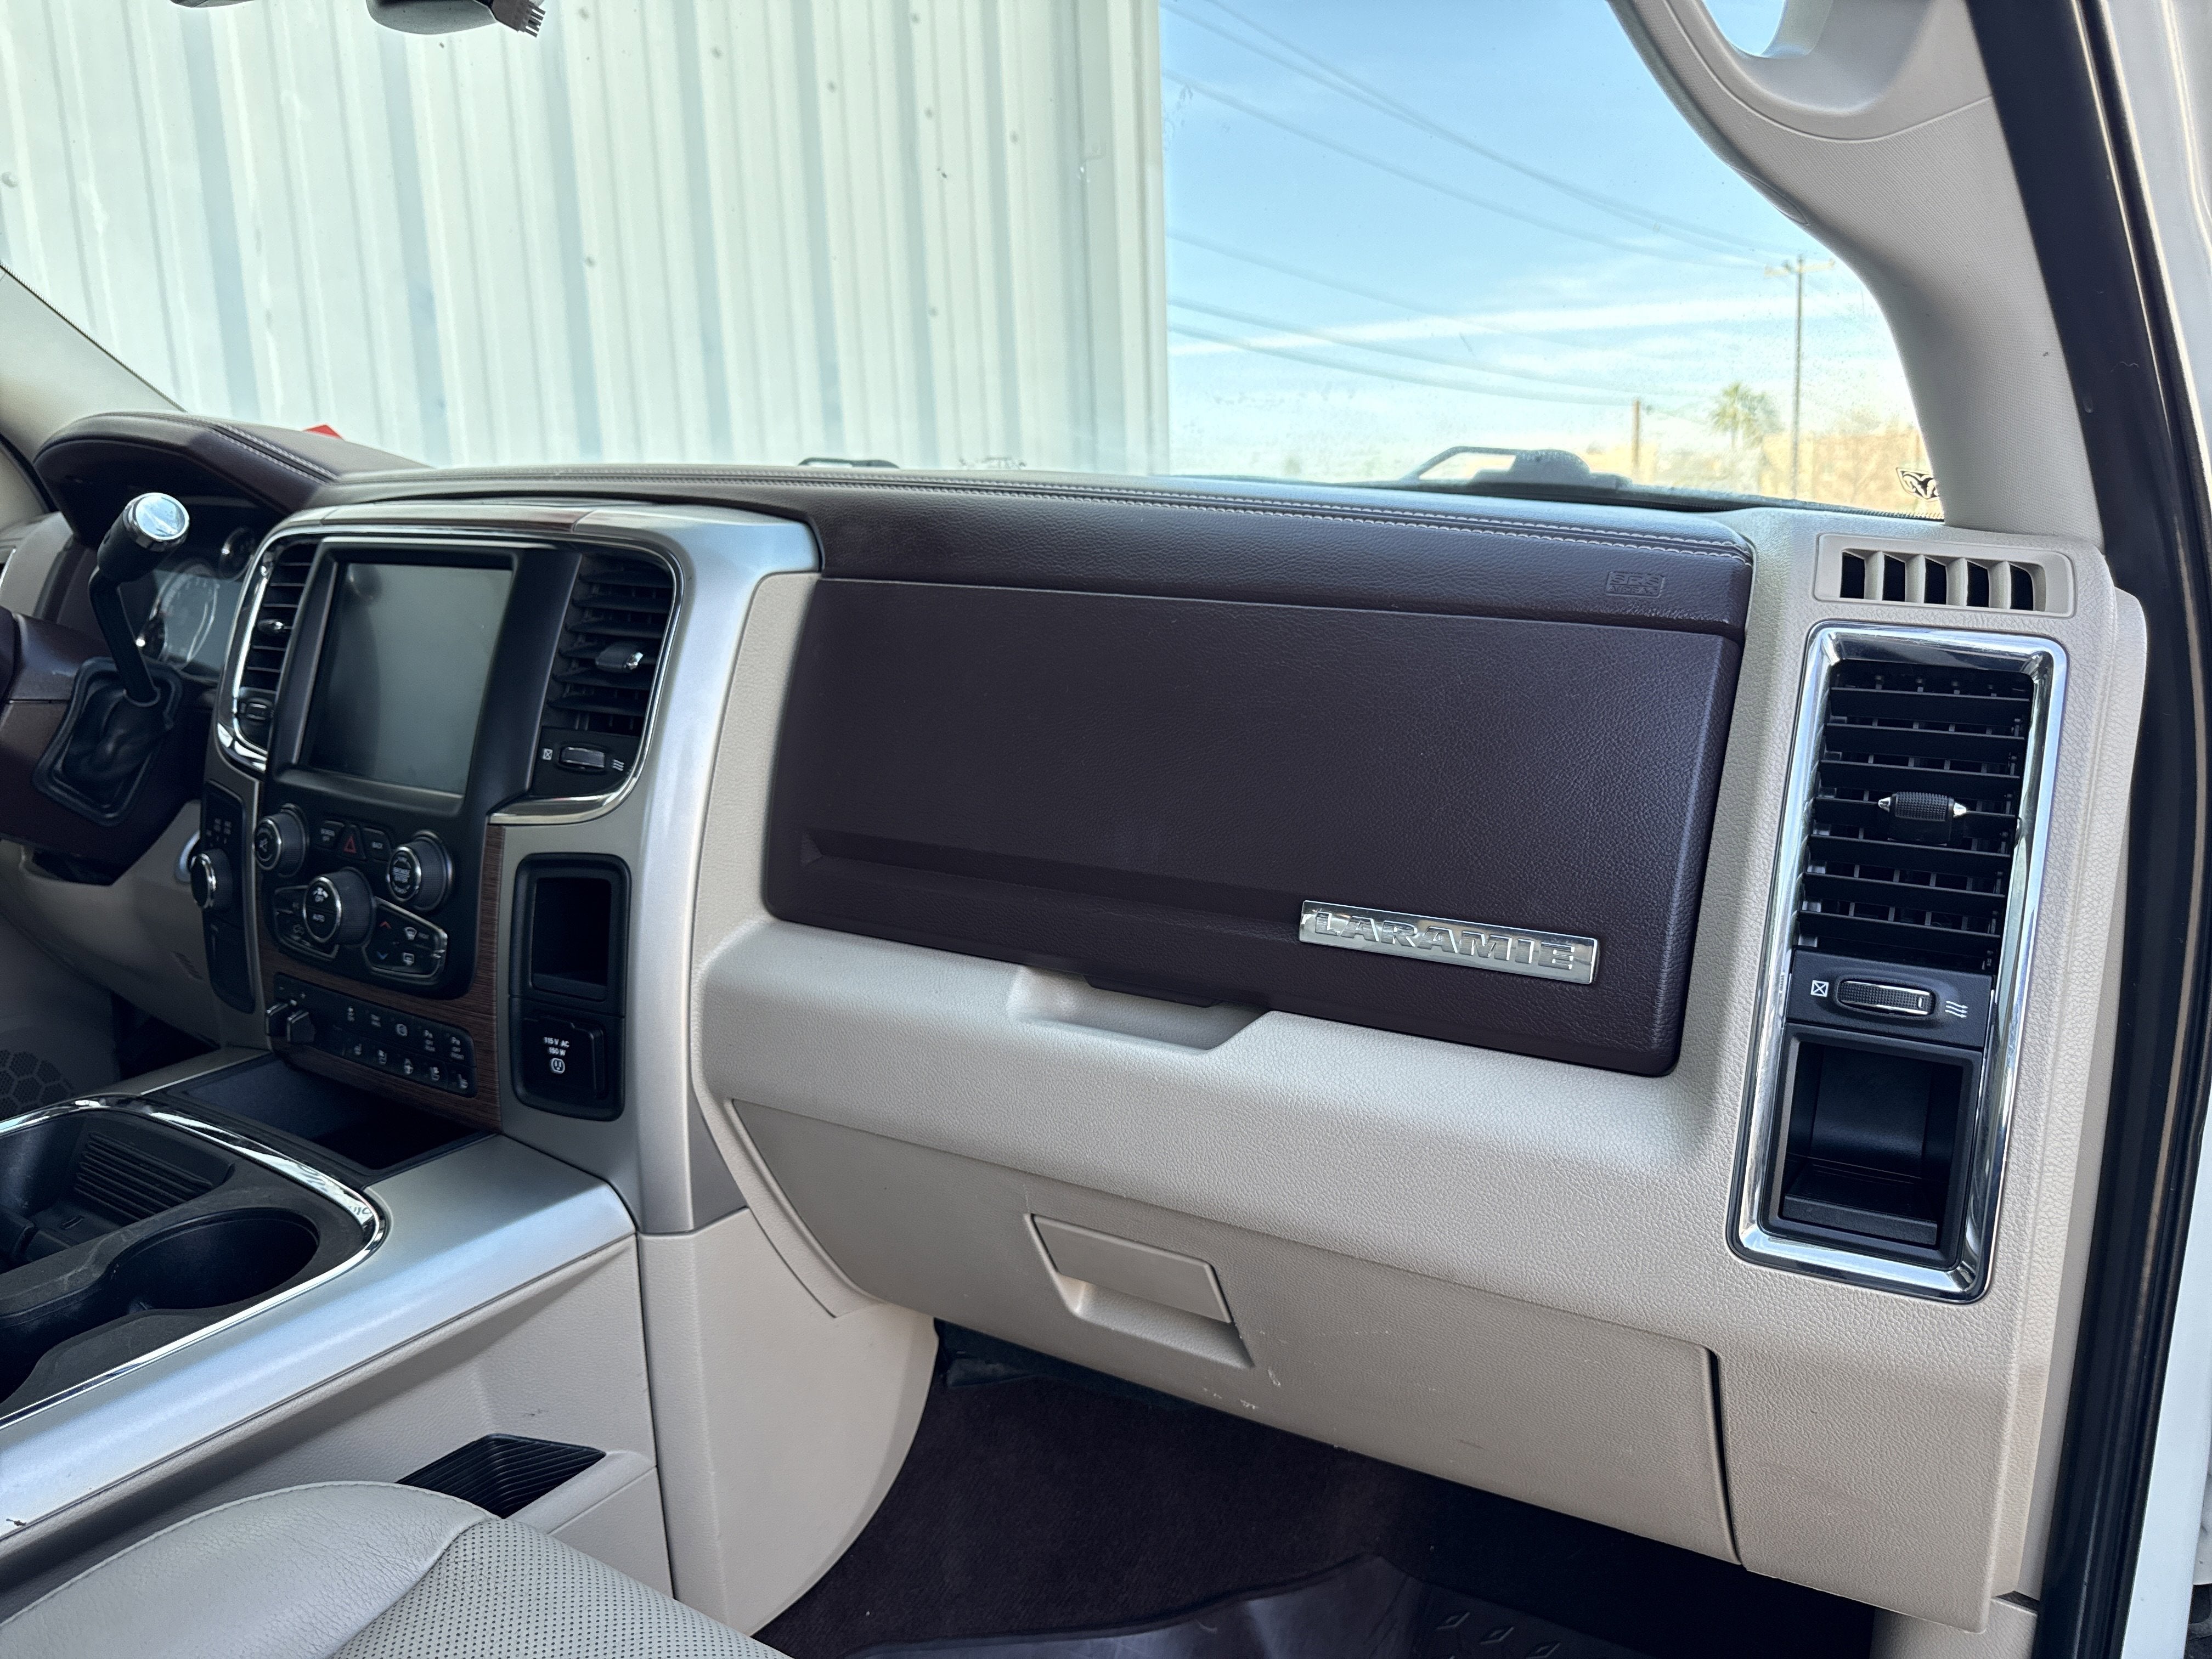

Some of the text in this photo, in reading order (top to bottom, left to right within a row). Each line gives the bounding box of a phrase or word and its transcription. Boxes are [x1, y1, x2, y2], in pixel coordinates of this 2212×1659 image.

[1611, 574, 1659, 585] SRS
[1607, 585, 1658, 595] AIRBAG
[1314, 911, 1576, 970] LARAMIE
